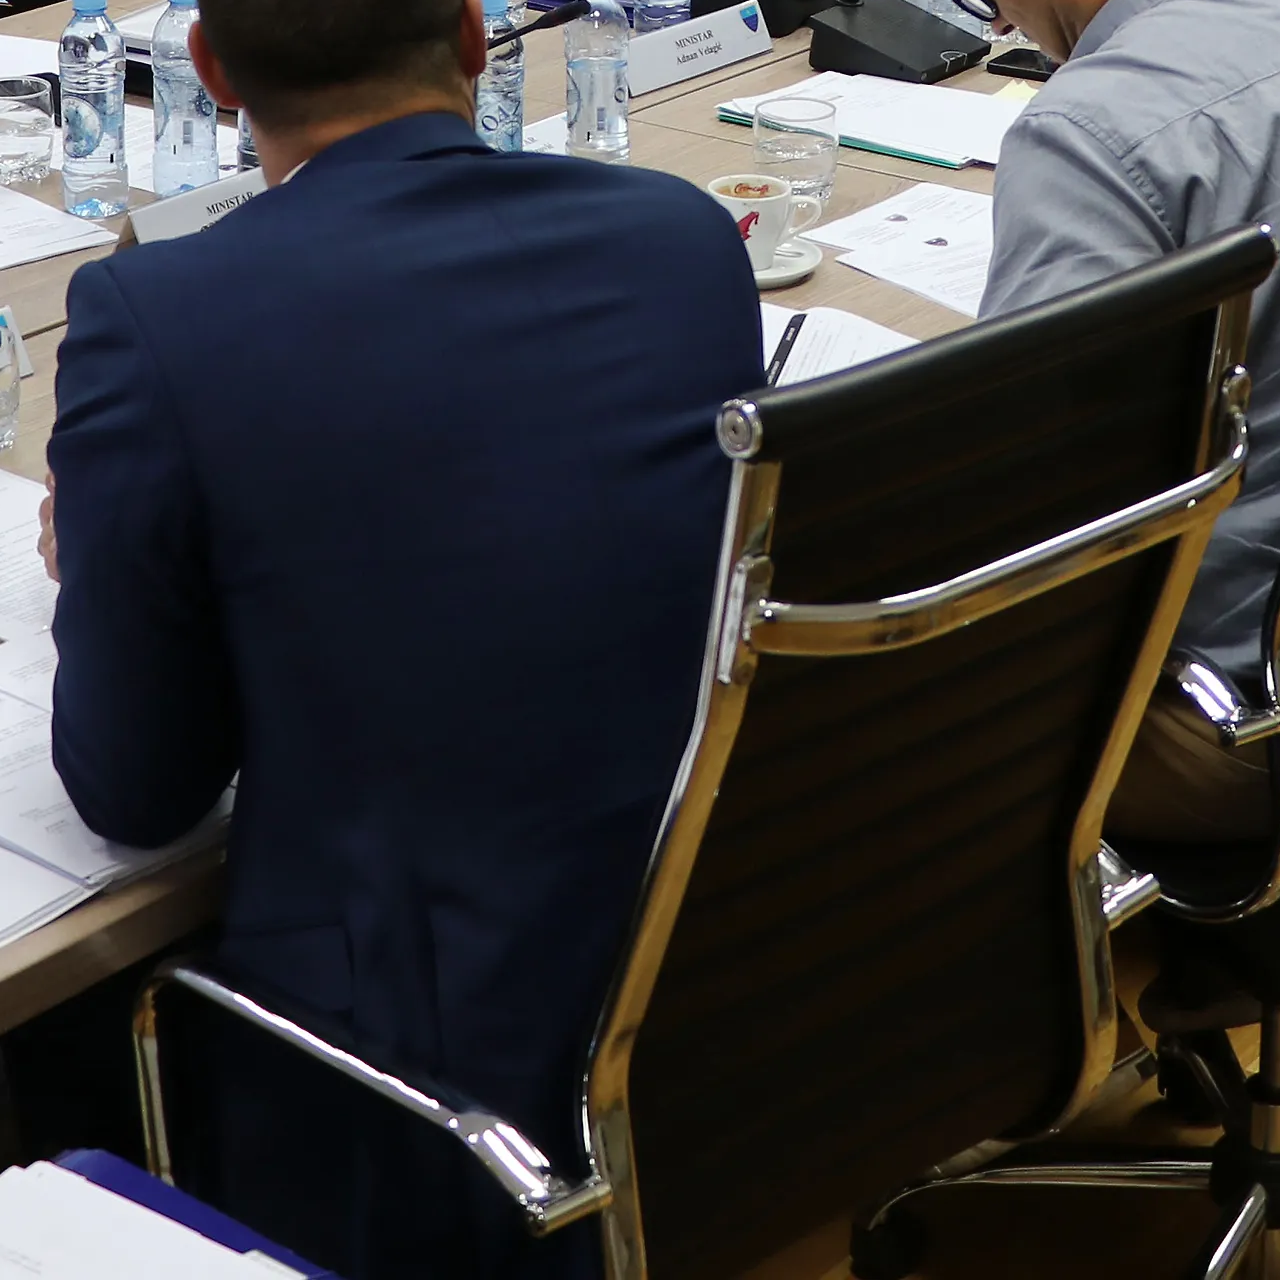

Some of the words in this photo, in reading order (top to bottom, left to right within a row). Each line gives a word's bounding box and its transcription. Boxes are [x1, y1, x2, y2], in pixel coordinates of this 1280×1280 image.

[675, 29, 713, 48] MINISTAR
[676, 52, 698, 65] Adnan
[206, 191, 253, 217] MINISTAR
